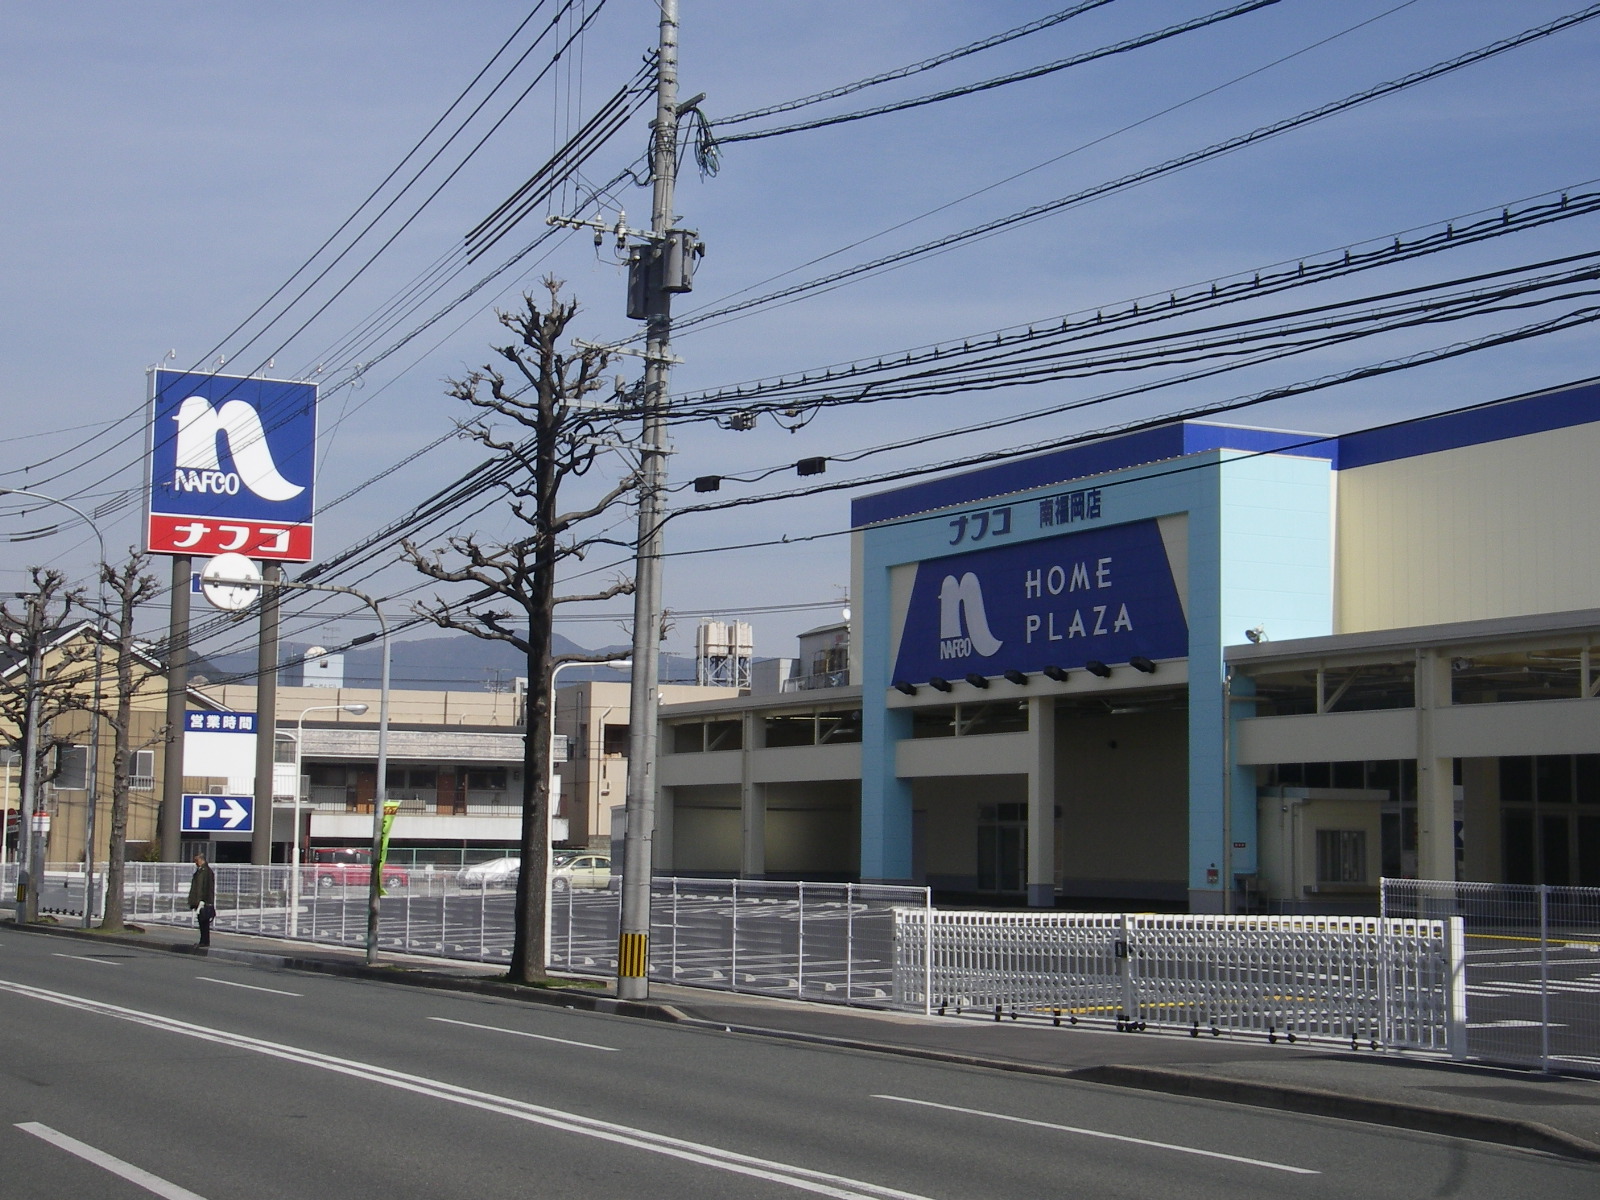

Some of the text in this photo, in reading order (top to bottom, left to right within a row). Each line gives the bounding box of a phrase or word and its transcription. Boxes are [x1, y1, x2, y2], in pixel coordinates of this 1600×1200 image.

[175, 469, 240, 495] NAFCO
[949, 489, 1102, 545] ナフコ 南福岡店
[173, 523, 290, 552] ナフコ
[1026, 557, 1112, 598] HOME
[1026, 603, 1133, 643] PLAZA
[940, 637, 972, 660] NAFCO
[190, 714, 253, 730] 営業時間
[191, 798, 216, 828] P
